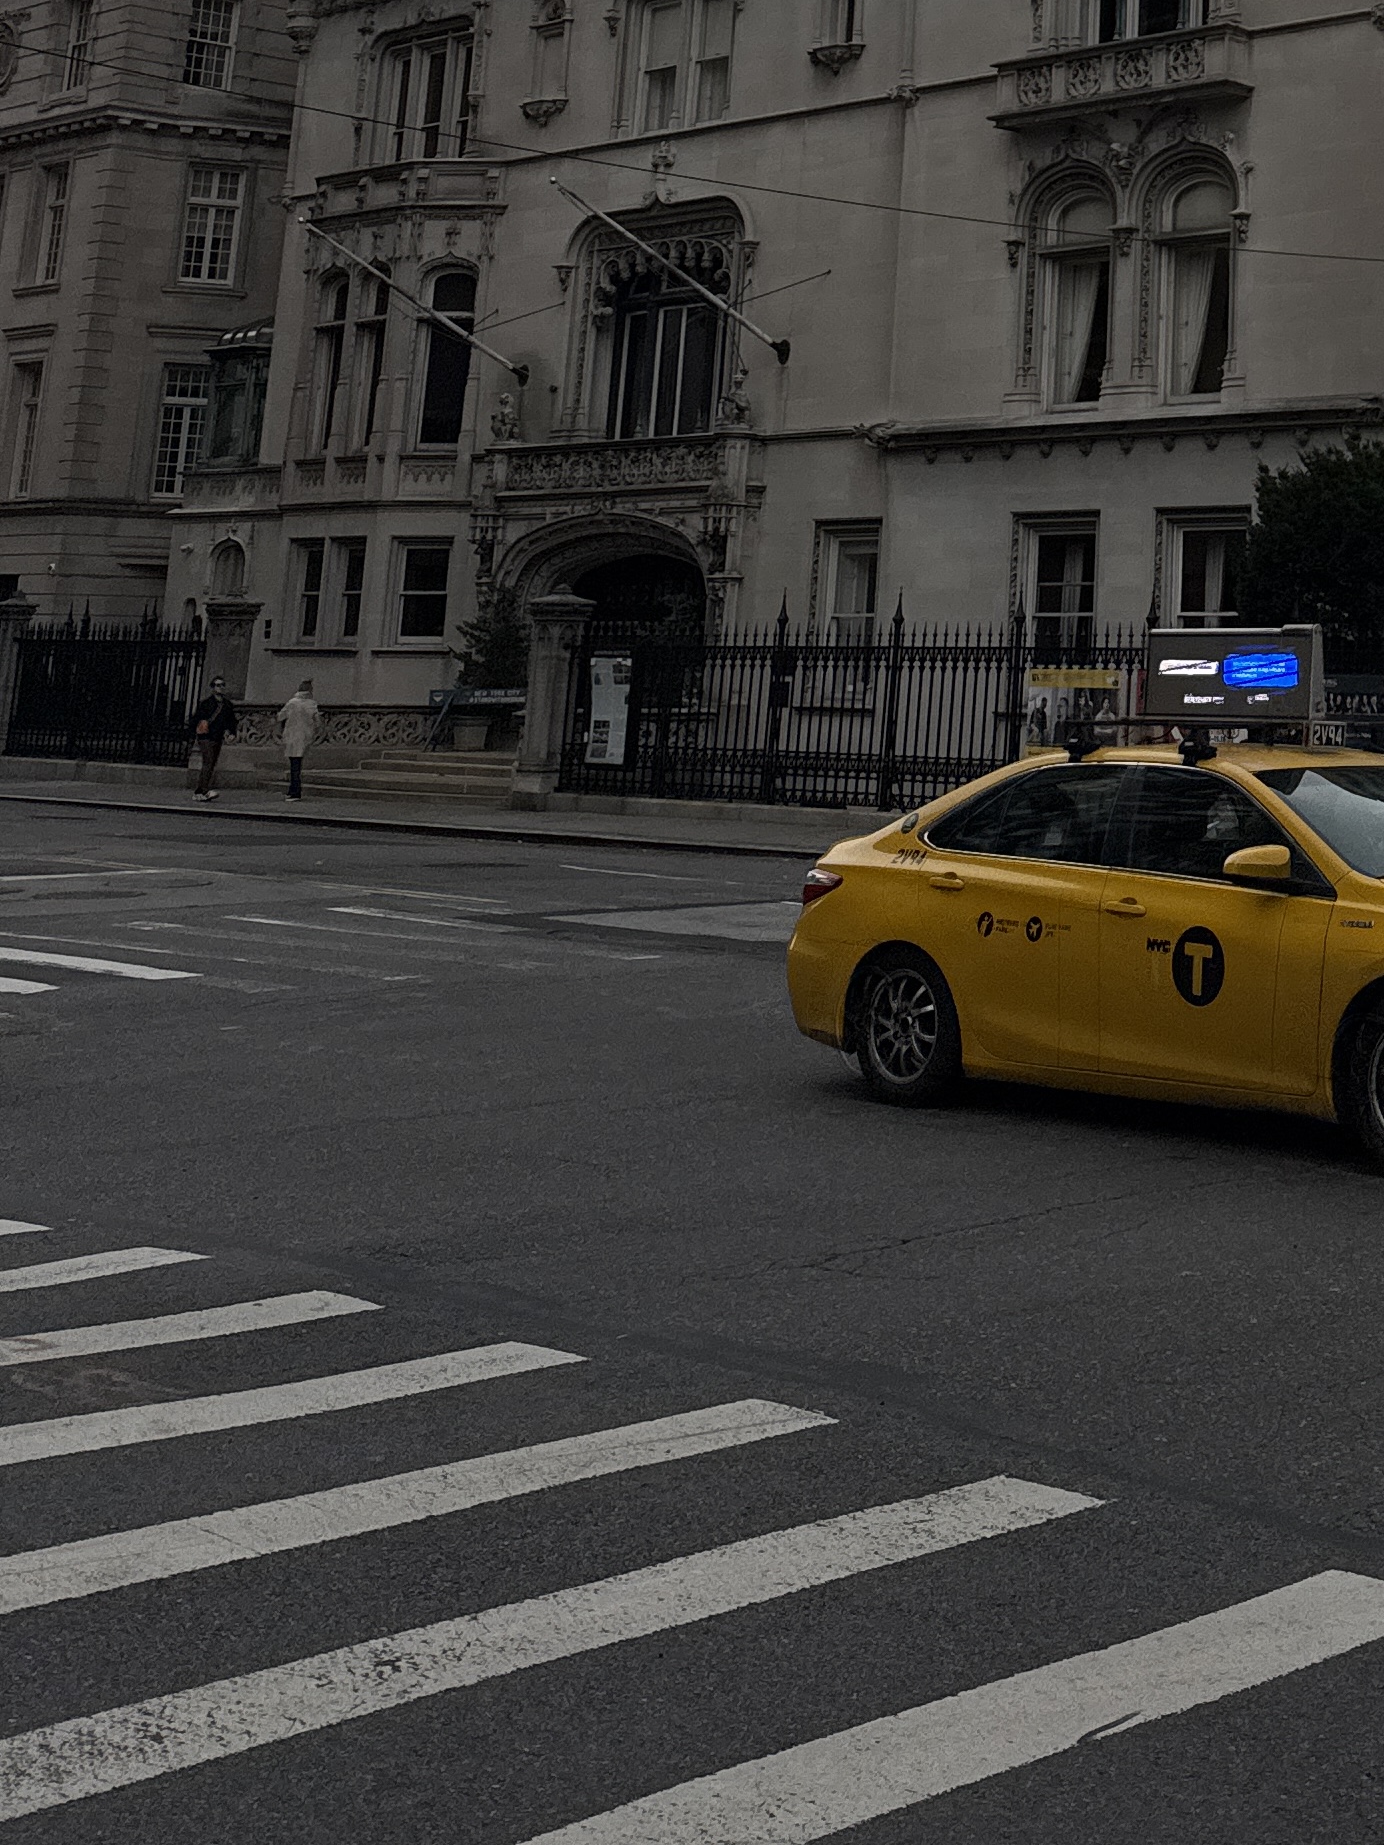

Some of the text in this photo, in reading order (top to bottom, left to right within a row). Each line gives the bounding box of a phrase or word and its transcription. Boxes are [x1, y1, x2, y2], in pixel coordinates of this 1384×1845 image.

[1313, 725, 1343, 746] 2V94
[1146, 937, 1171, 953] NYC
[1184, 941, 1213, 997] T
